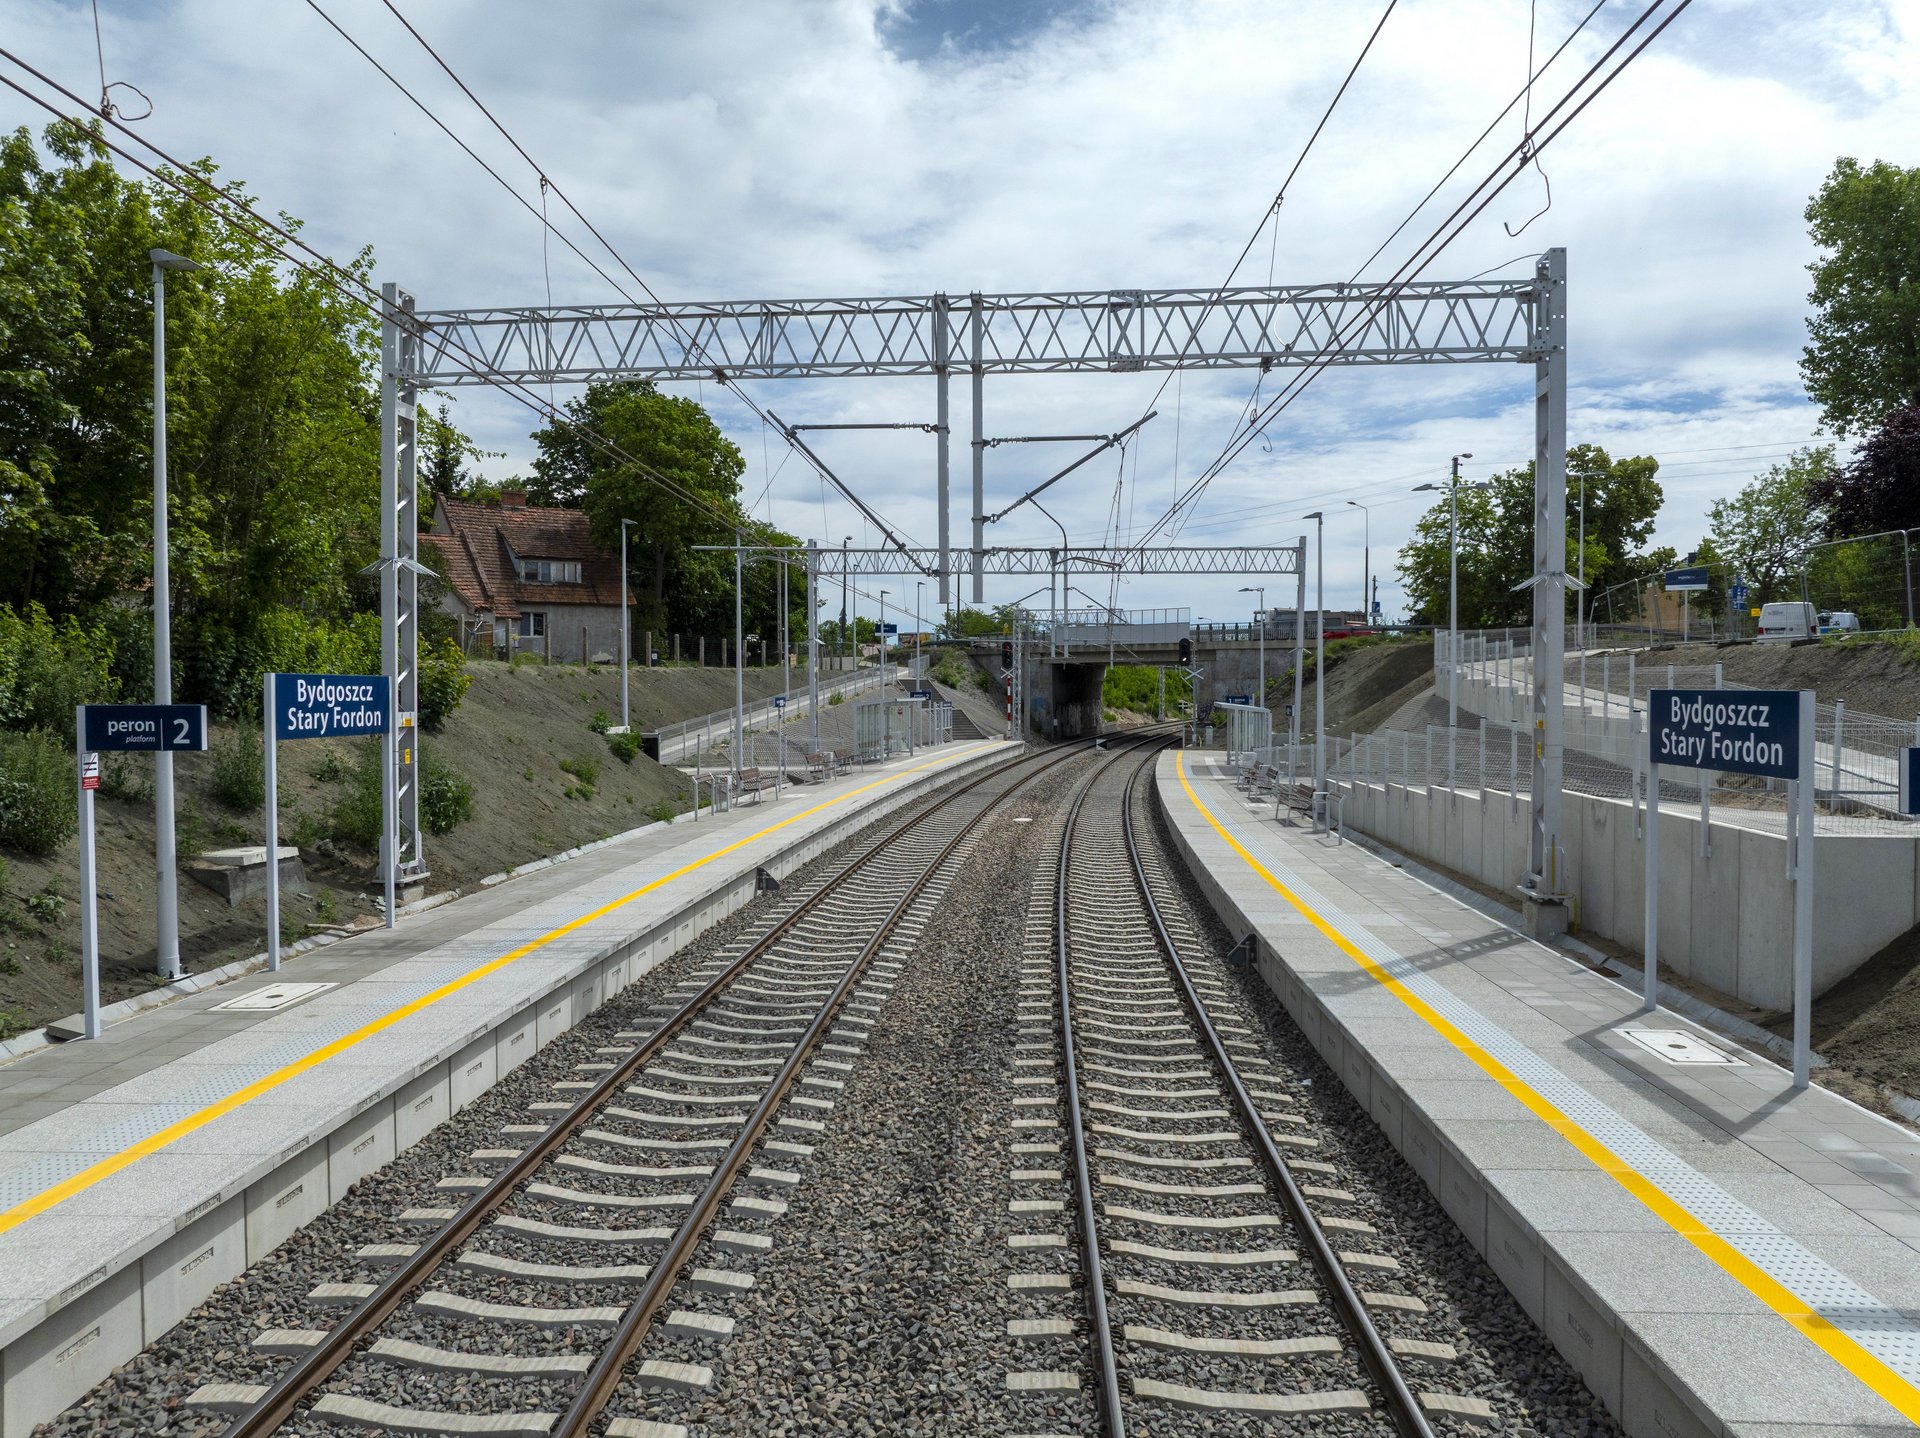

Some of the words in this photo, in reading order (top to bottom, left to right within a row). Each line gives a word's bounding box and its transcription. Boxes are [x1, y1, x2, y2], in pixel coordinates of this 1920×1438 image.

[297, 678, 374, 709] Bydgoszcz
[287, 707, 329, 736] Stary
[333, 704, 382, 729] Fordon
[1671, 695, 1770, 732] Bydgoszcz
[107, 720, 155, 736] peron
[173, 718, 191, 744] 2
[125, 734, 156, 744] platform
[1661, 727, 1706, 765] Stary
[1711, 731, 1783, 766] Fordon
